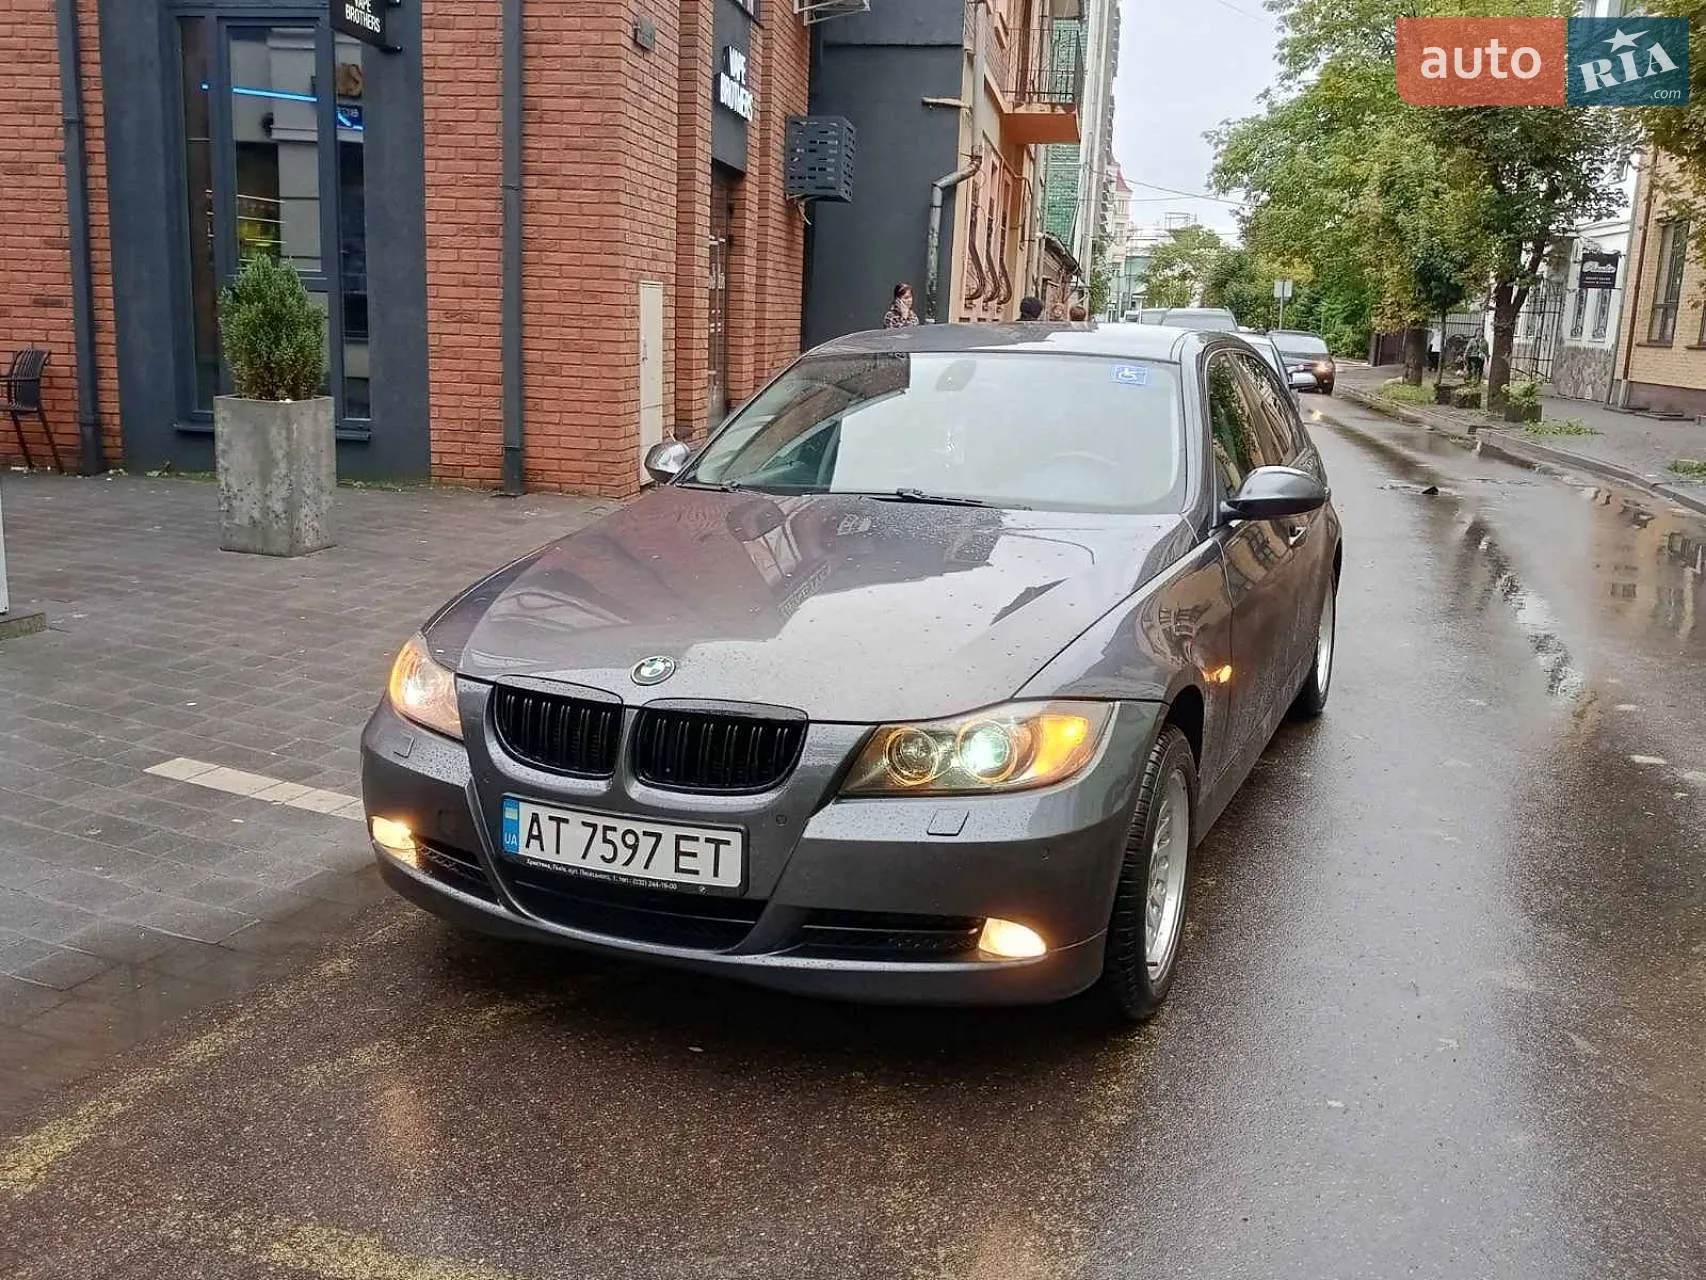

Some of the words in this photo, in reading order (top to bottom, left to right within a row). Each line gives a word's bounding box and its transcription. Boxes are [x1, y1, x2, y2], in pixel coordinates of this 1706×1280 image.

[345, 3, 381, 33] BROTHERS
[504, 831, 518, 846] UA
[525, 812, 570, 855] AT
[580, 820, 663, 870] 7597
[674, 833, 732, 878] ET
